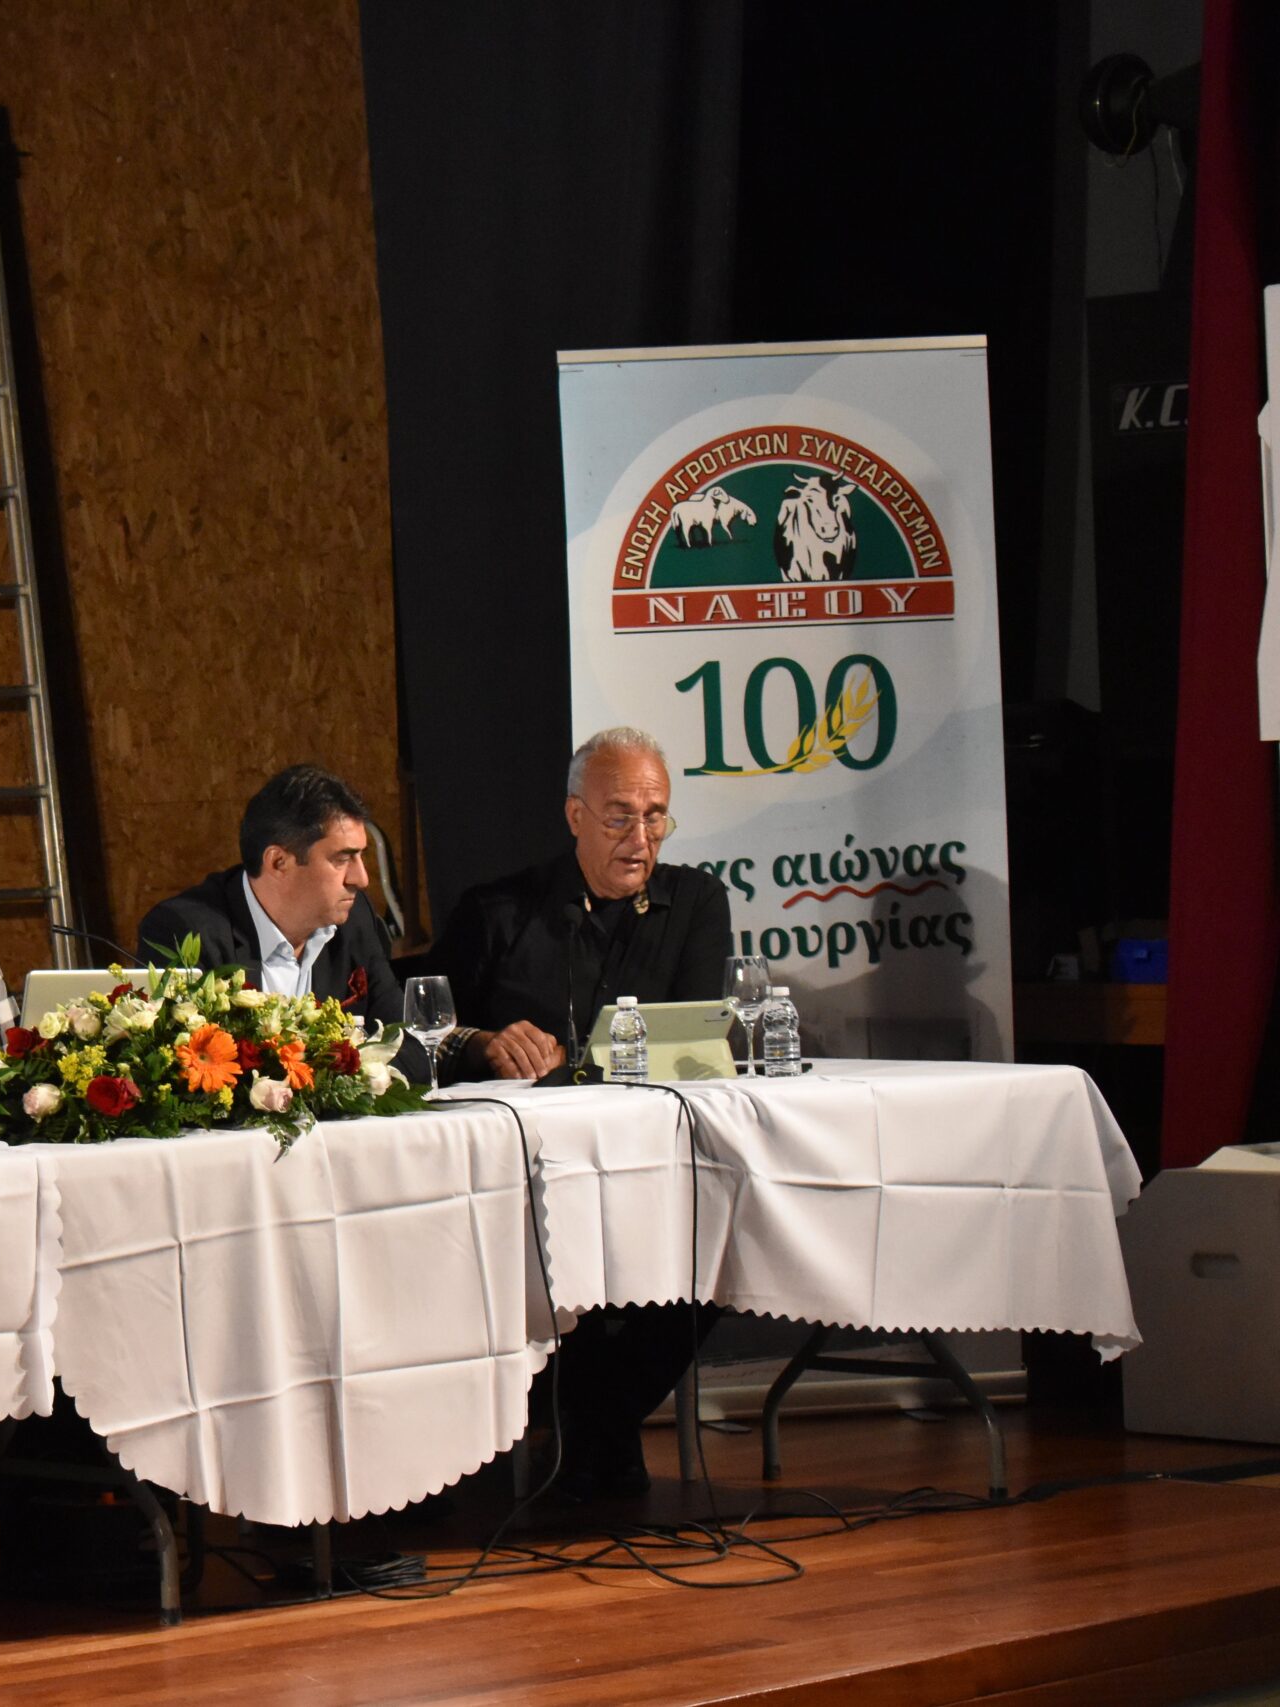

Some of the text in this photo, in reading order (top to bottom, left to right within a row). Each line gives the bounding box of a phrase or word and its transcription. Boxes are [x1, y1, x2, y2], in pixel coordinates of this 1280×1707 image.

[620, 432, 943, 581] ΕΝΩΣΗ ΑΓΡΟΤΙΚΩΝ ΣΥΝΕΤΑΙΡΙΣΜΩΝ
[646, 586, 920, 625] ΝΑΞΟΥ
[675, 654, 898, 777] 100
[772, 834, 967, 887] αιώνας
[728, 902, 974, 968] ιουργίας
